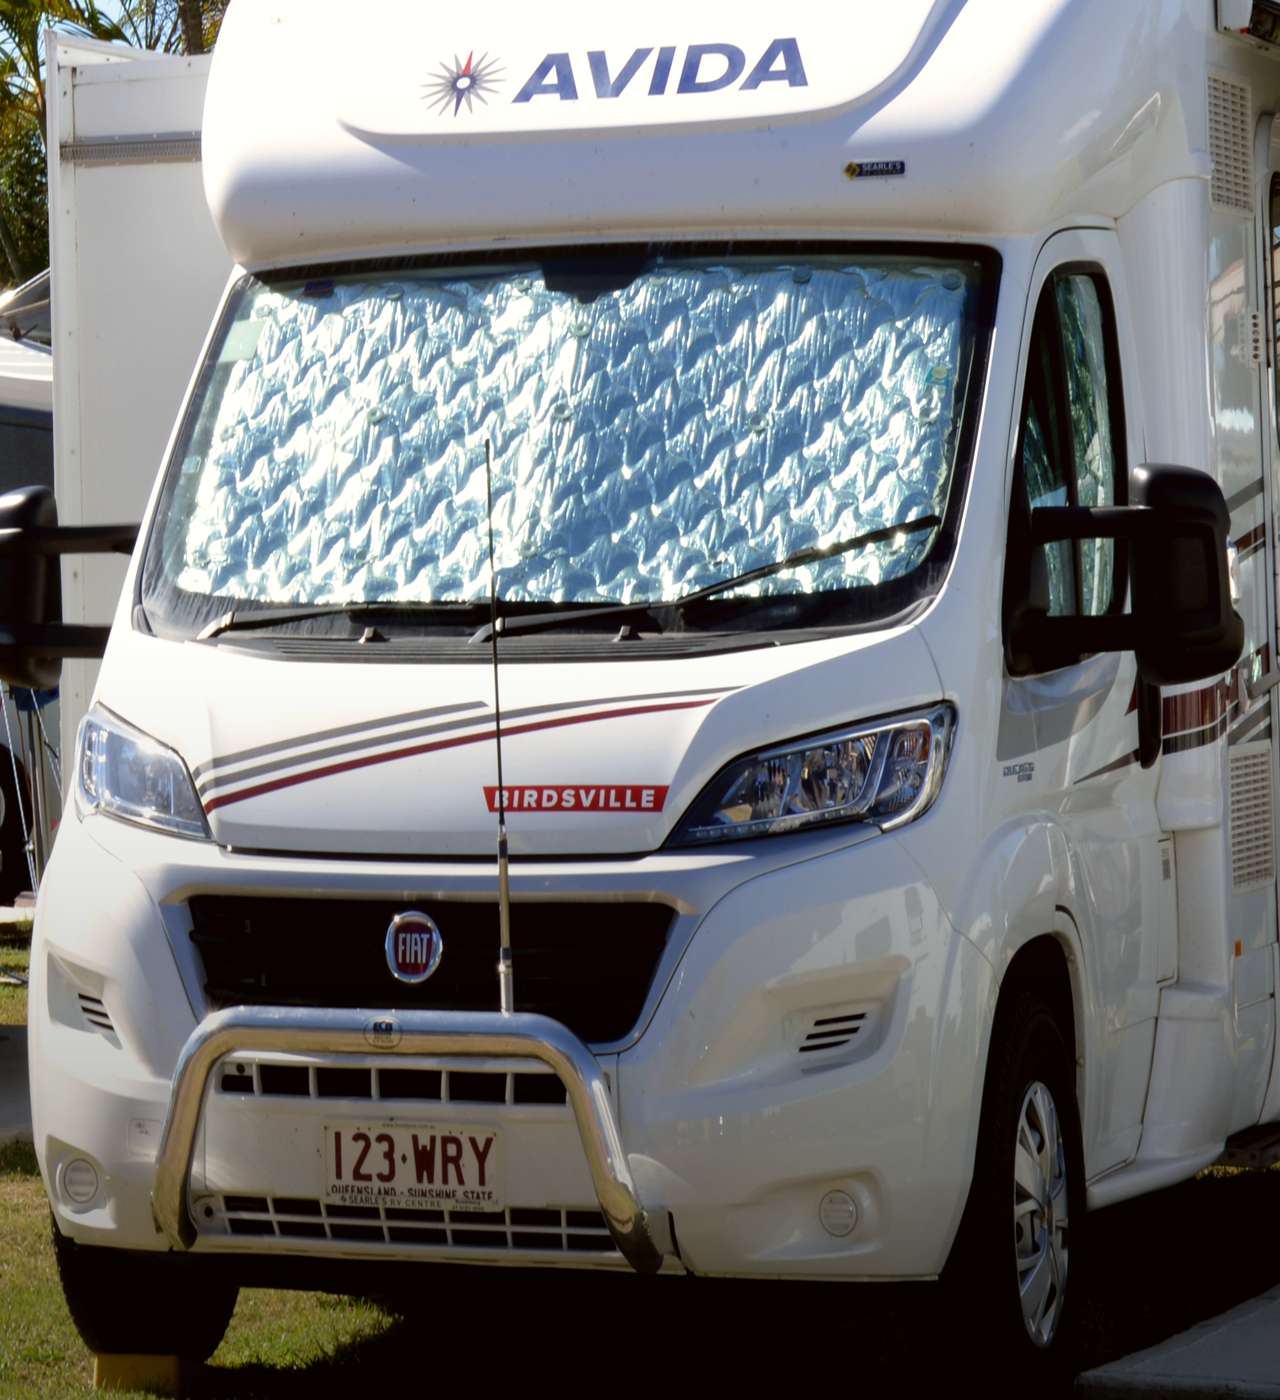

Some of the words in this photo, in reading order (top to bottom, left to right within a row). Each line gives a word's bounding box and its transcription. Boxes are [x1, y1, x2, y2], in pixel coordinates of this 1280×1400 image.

[511, 37, 809, 104] AVIDA
[493, 788, 655, 809] BIRDSVILLE
[398, 933, 430, 964] FIAT
[330, 1183, 397, 1196] QUEENSLAND
[407, 1187, 458, 1199] SUNSHINE
[462, 1190, 494, 1200] STATE
